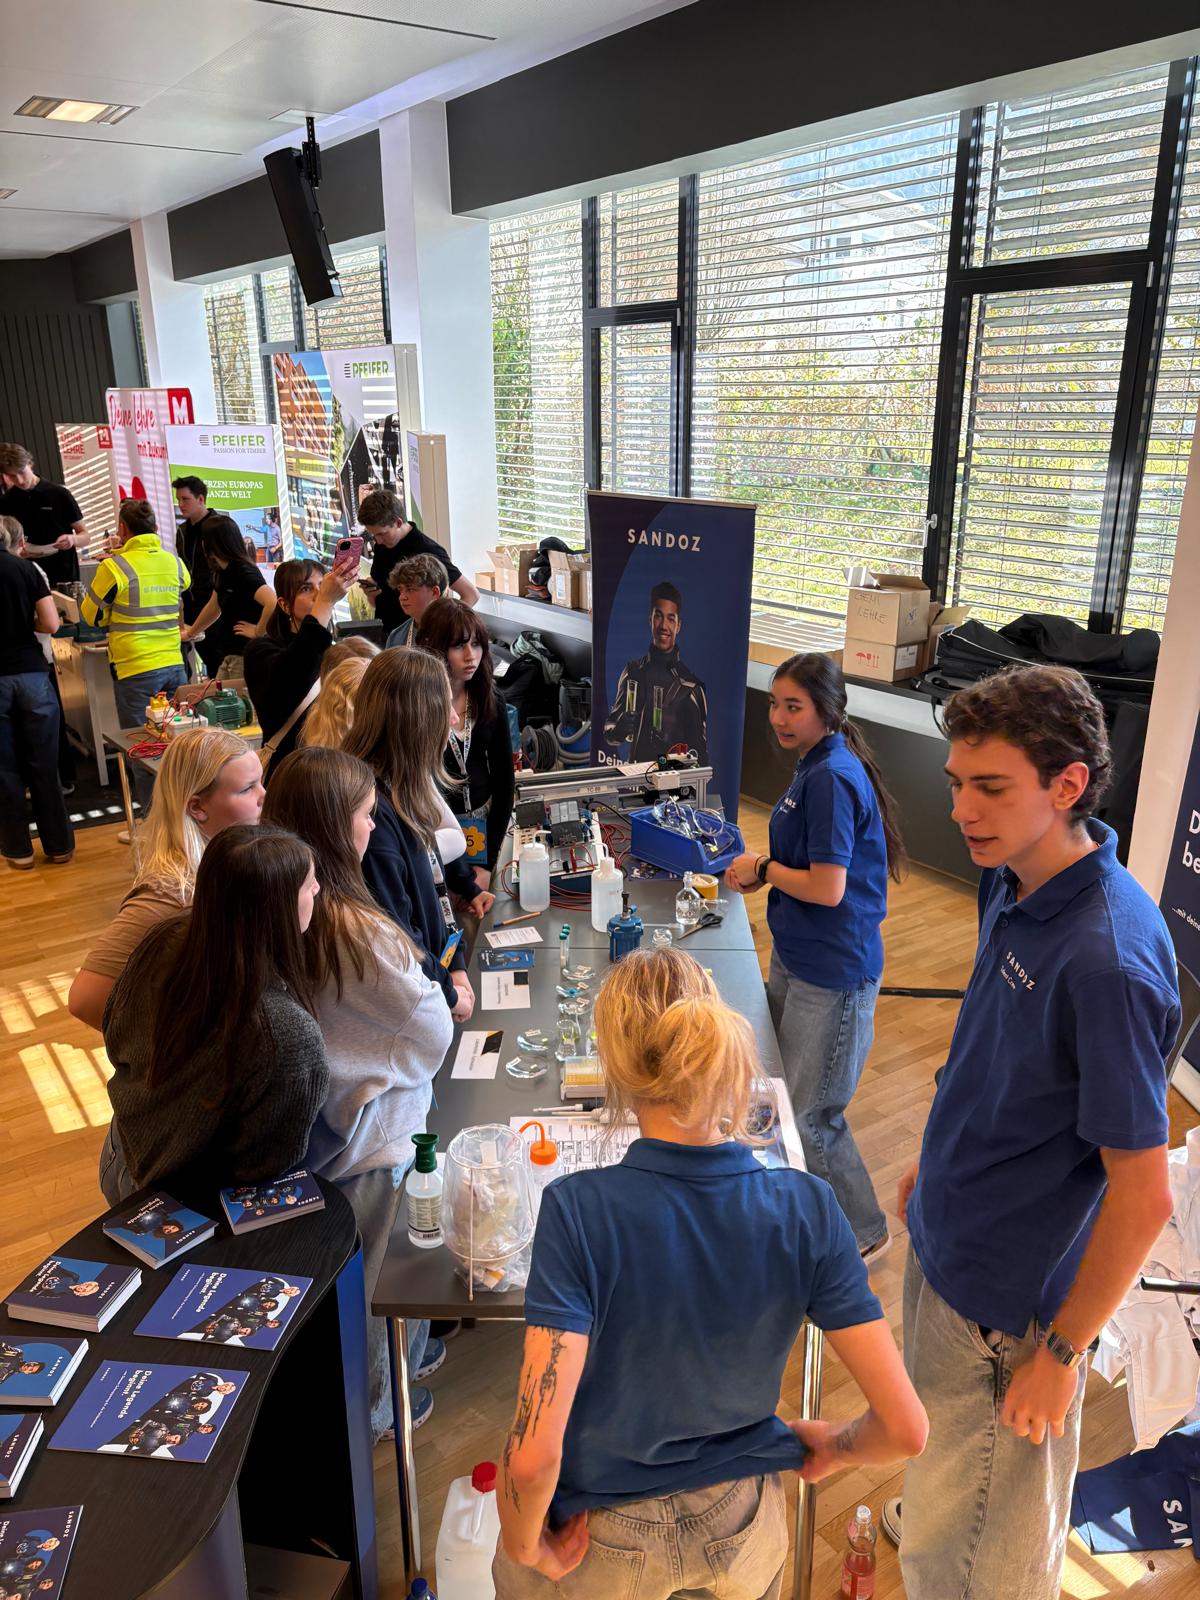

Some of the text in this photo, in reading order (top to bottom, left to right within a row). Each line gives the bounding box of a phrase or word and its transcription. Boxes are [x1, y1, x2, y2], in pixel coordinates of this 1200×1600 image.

[352, 361, 389, 377] PFEIFER
[212, 434, 265, 446] PFEIFER
[229, 480, 264, 489] EUROPAS
[231, 490, 252, 499] WELT
[627, 528, 701, 552] SANDOZ
[466, 834, 475, 847] 5
[1182, 840, 1200, 875] be
[1006, 951, 1036, 991] SANDOZ
[117, 1370, 153, 1419] Deine Legende
[121, 1369, 144, 1396] beginnt.
[63, 1510, 75, 1538] SANDOZ
